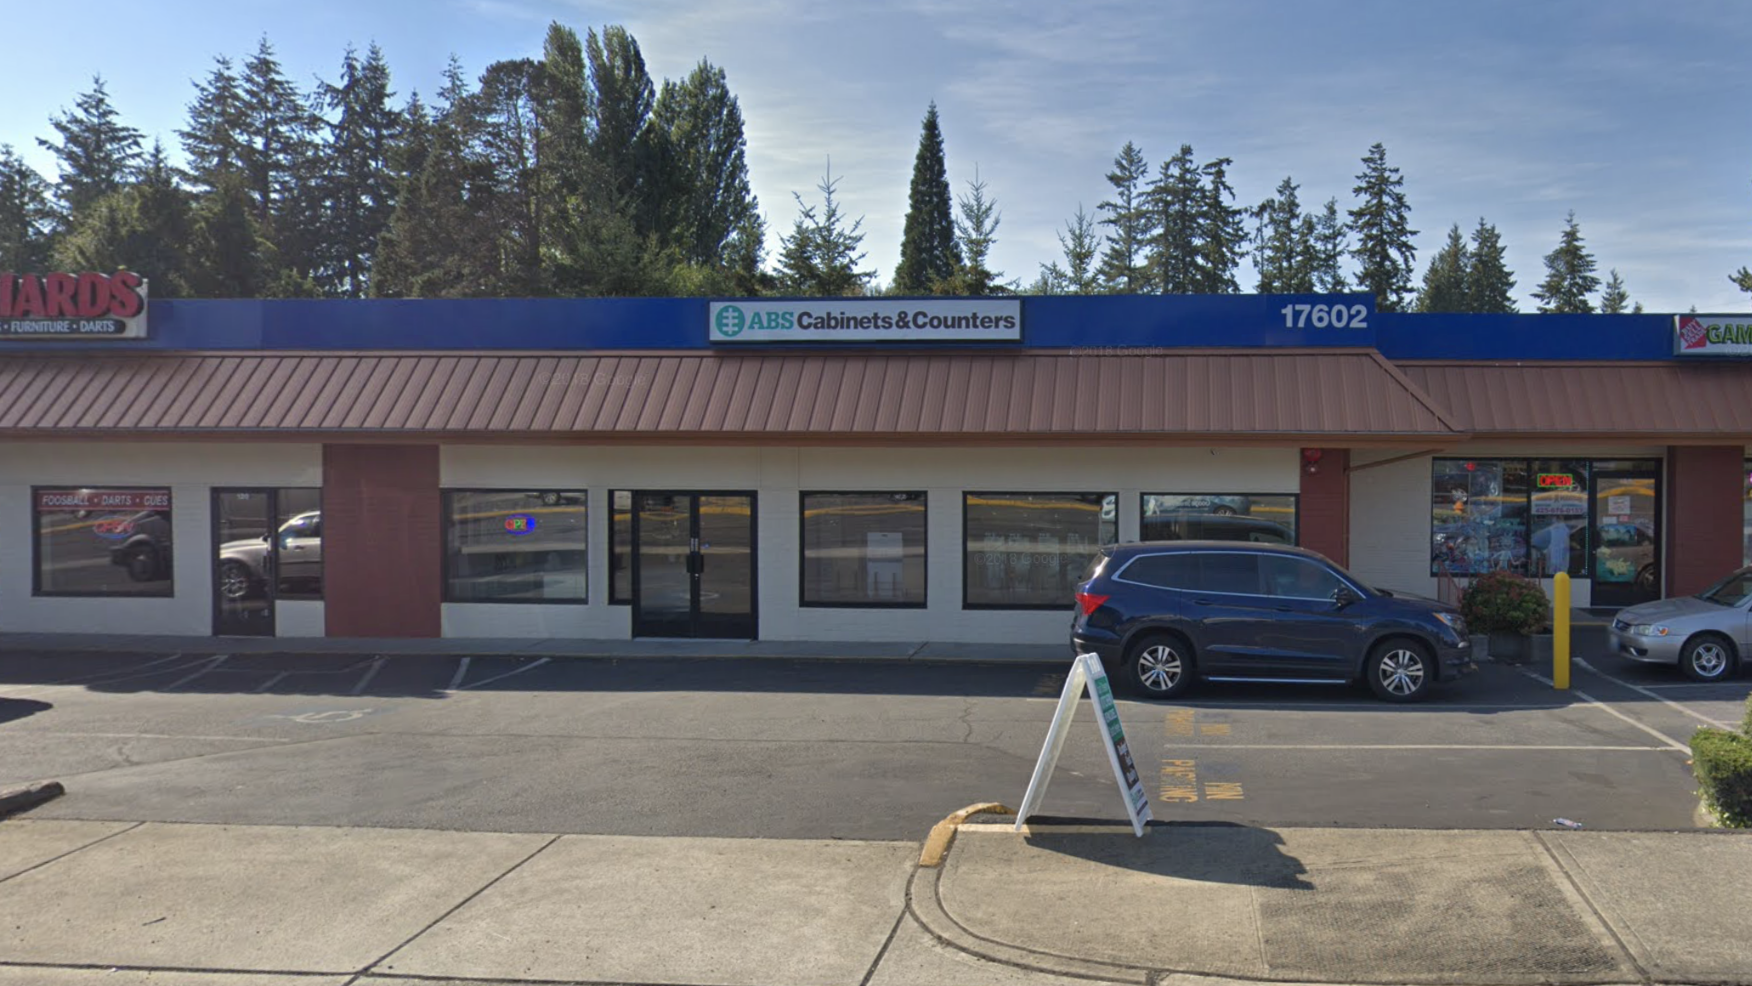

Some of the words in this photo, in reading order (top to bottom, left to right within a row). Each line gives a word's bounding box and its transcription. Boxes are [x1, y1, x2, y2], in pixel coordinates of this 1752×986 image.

[748, 311, 794, 330] ABS
[1281, 304, 1367, 328] 17602
[11, 321, 70, 332] FURNITURE
[80, 320, 115, 332] DARTS
[1540, 475, 1572, 486] OPEN
[42, 495, 89, 505] FOOSBALL
[101, 495, 132, 505] DARTS
[505, 518, 535, 530] OPE
[1159, 759, 1199, 803] PARING
